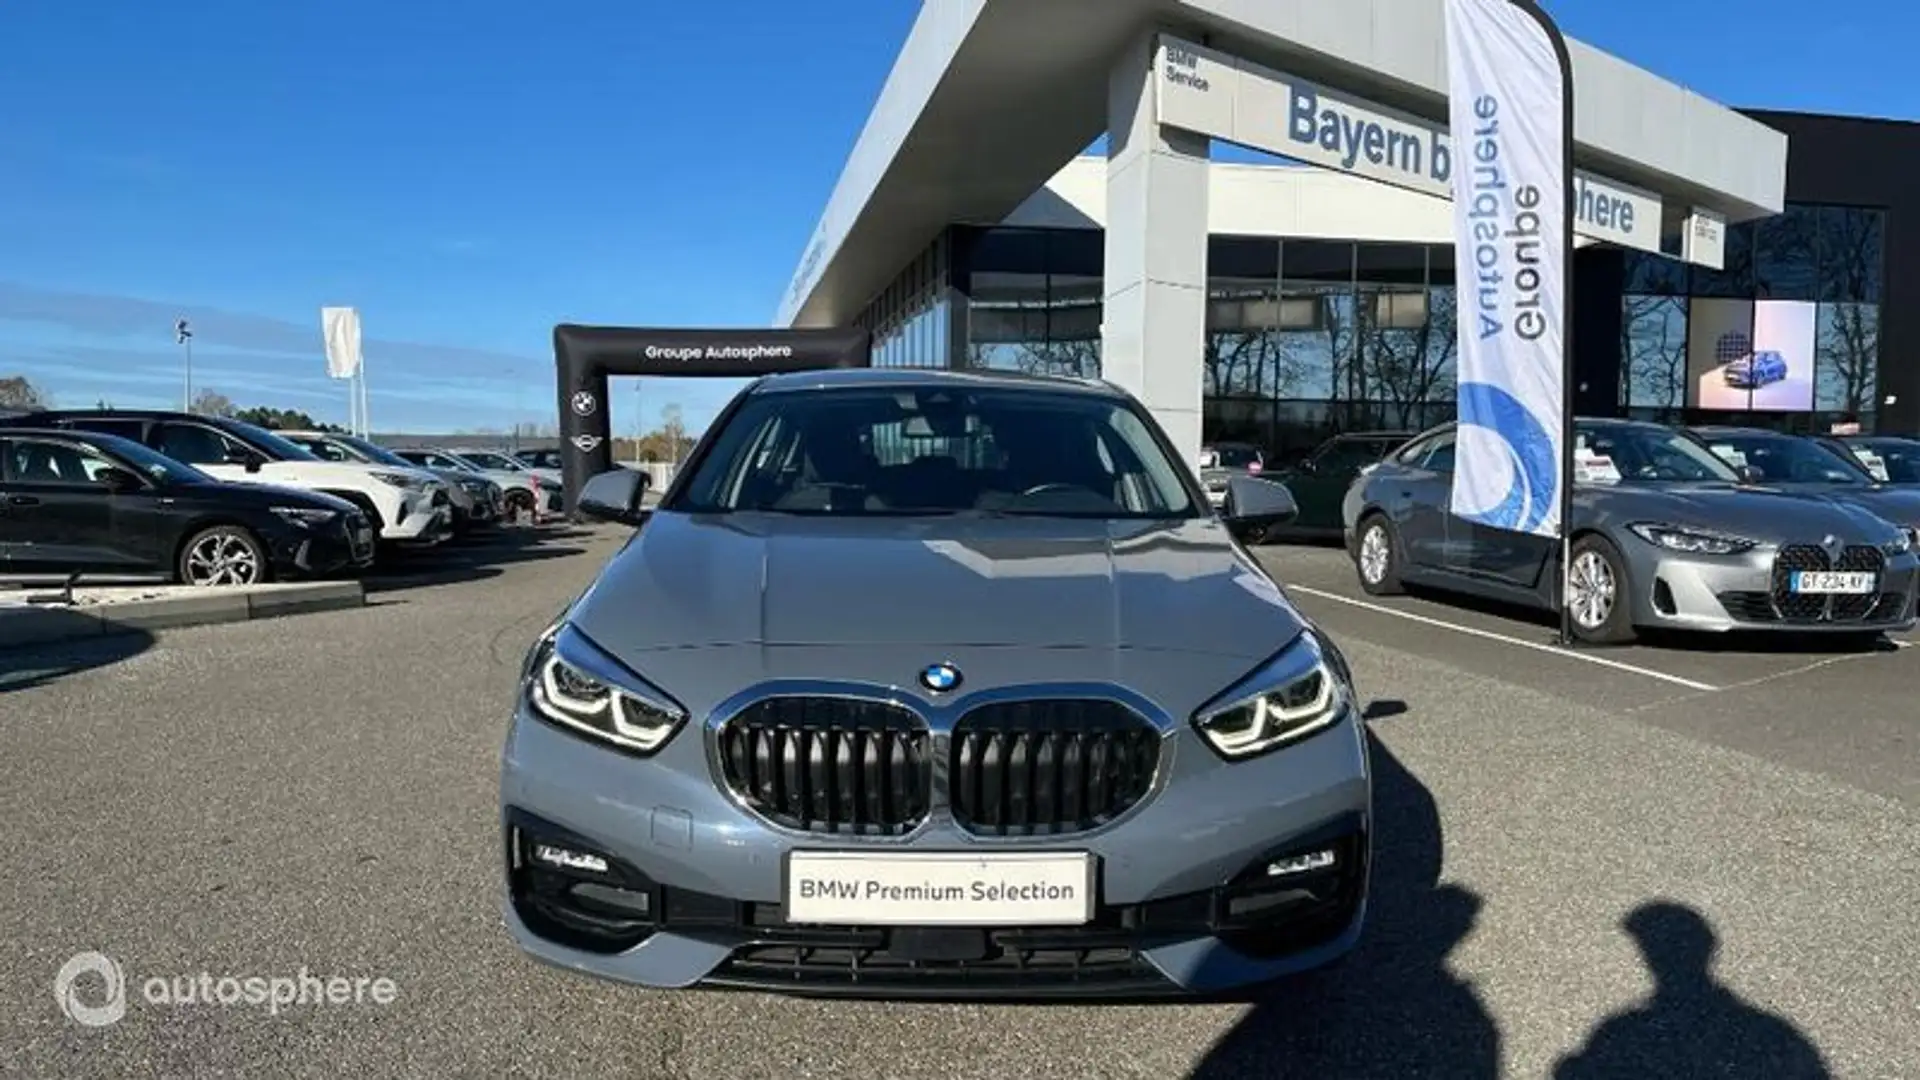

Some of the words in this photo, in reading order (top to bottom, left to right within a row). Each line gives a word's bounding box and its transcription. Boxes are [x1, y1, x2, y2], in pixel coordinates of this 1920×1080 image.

[1166, 65, 1209, 92] Service
[1288, 82, 1422, 169] Bayern
[1430, 130, 1451, 183] b
[645, 345, 702, 361] Groupe
[705, 343, 792, 361] Autosphere
[800, 878, 860, 900] BMW
[865, 880, 964, 901] Premium
[970, 880, 1075, 901] Selection
